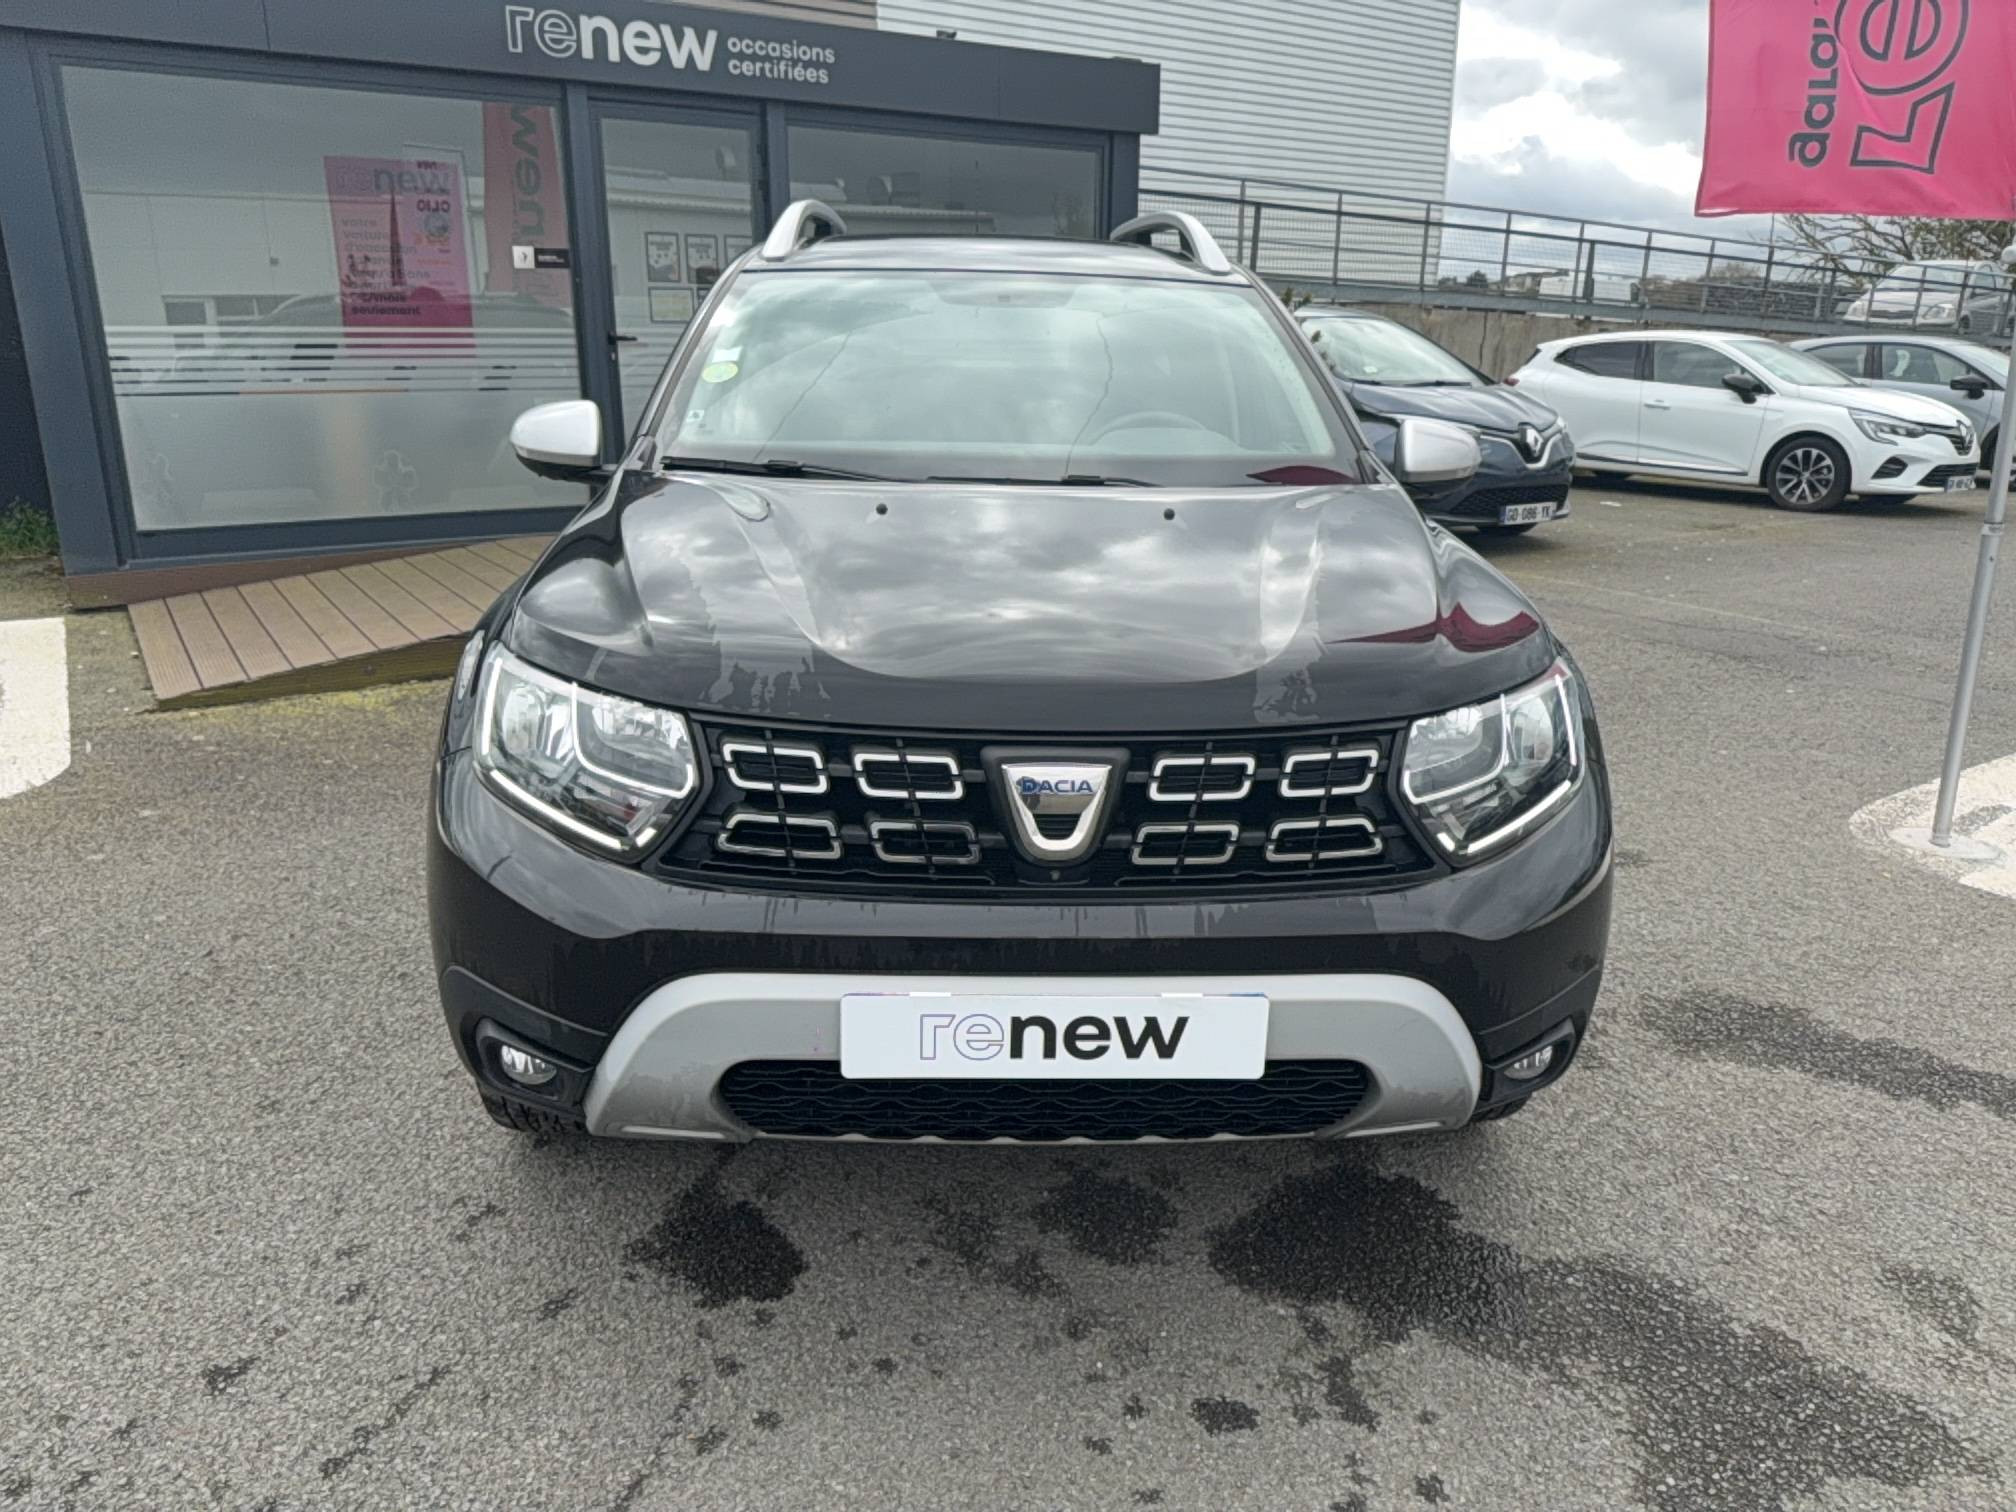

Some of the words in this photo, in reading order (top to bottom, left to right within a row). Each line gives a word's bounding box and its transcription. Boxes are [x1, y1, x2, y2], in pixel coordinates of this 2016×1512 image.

[505, 5, 718, 72] renew
[727, 37, 836, 64] occasions
[727, 57, 829, 84] certifiées
[1022, 779, 1094, 793] DACIA
[920, 1013, 1190, 1061] renew
